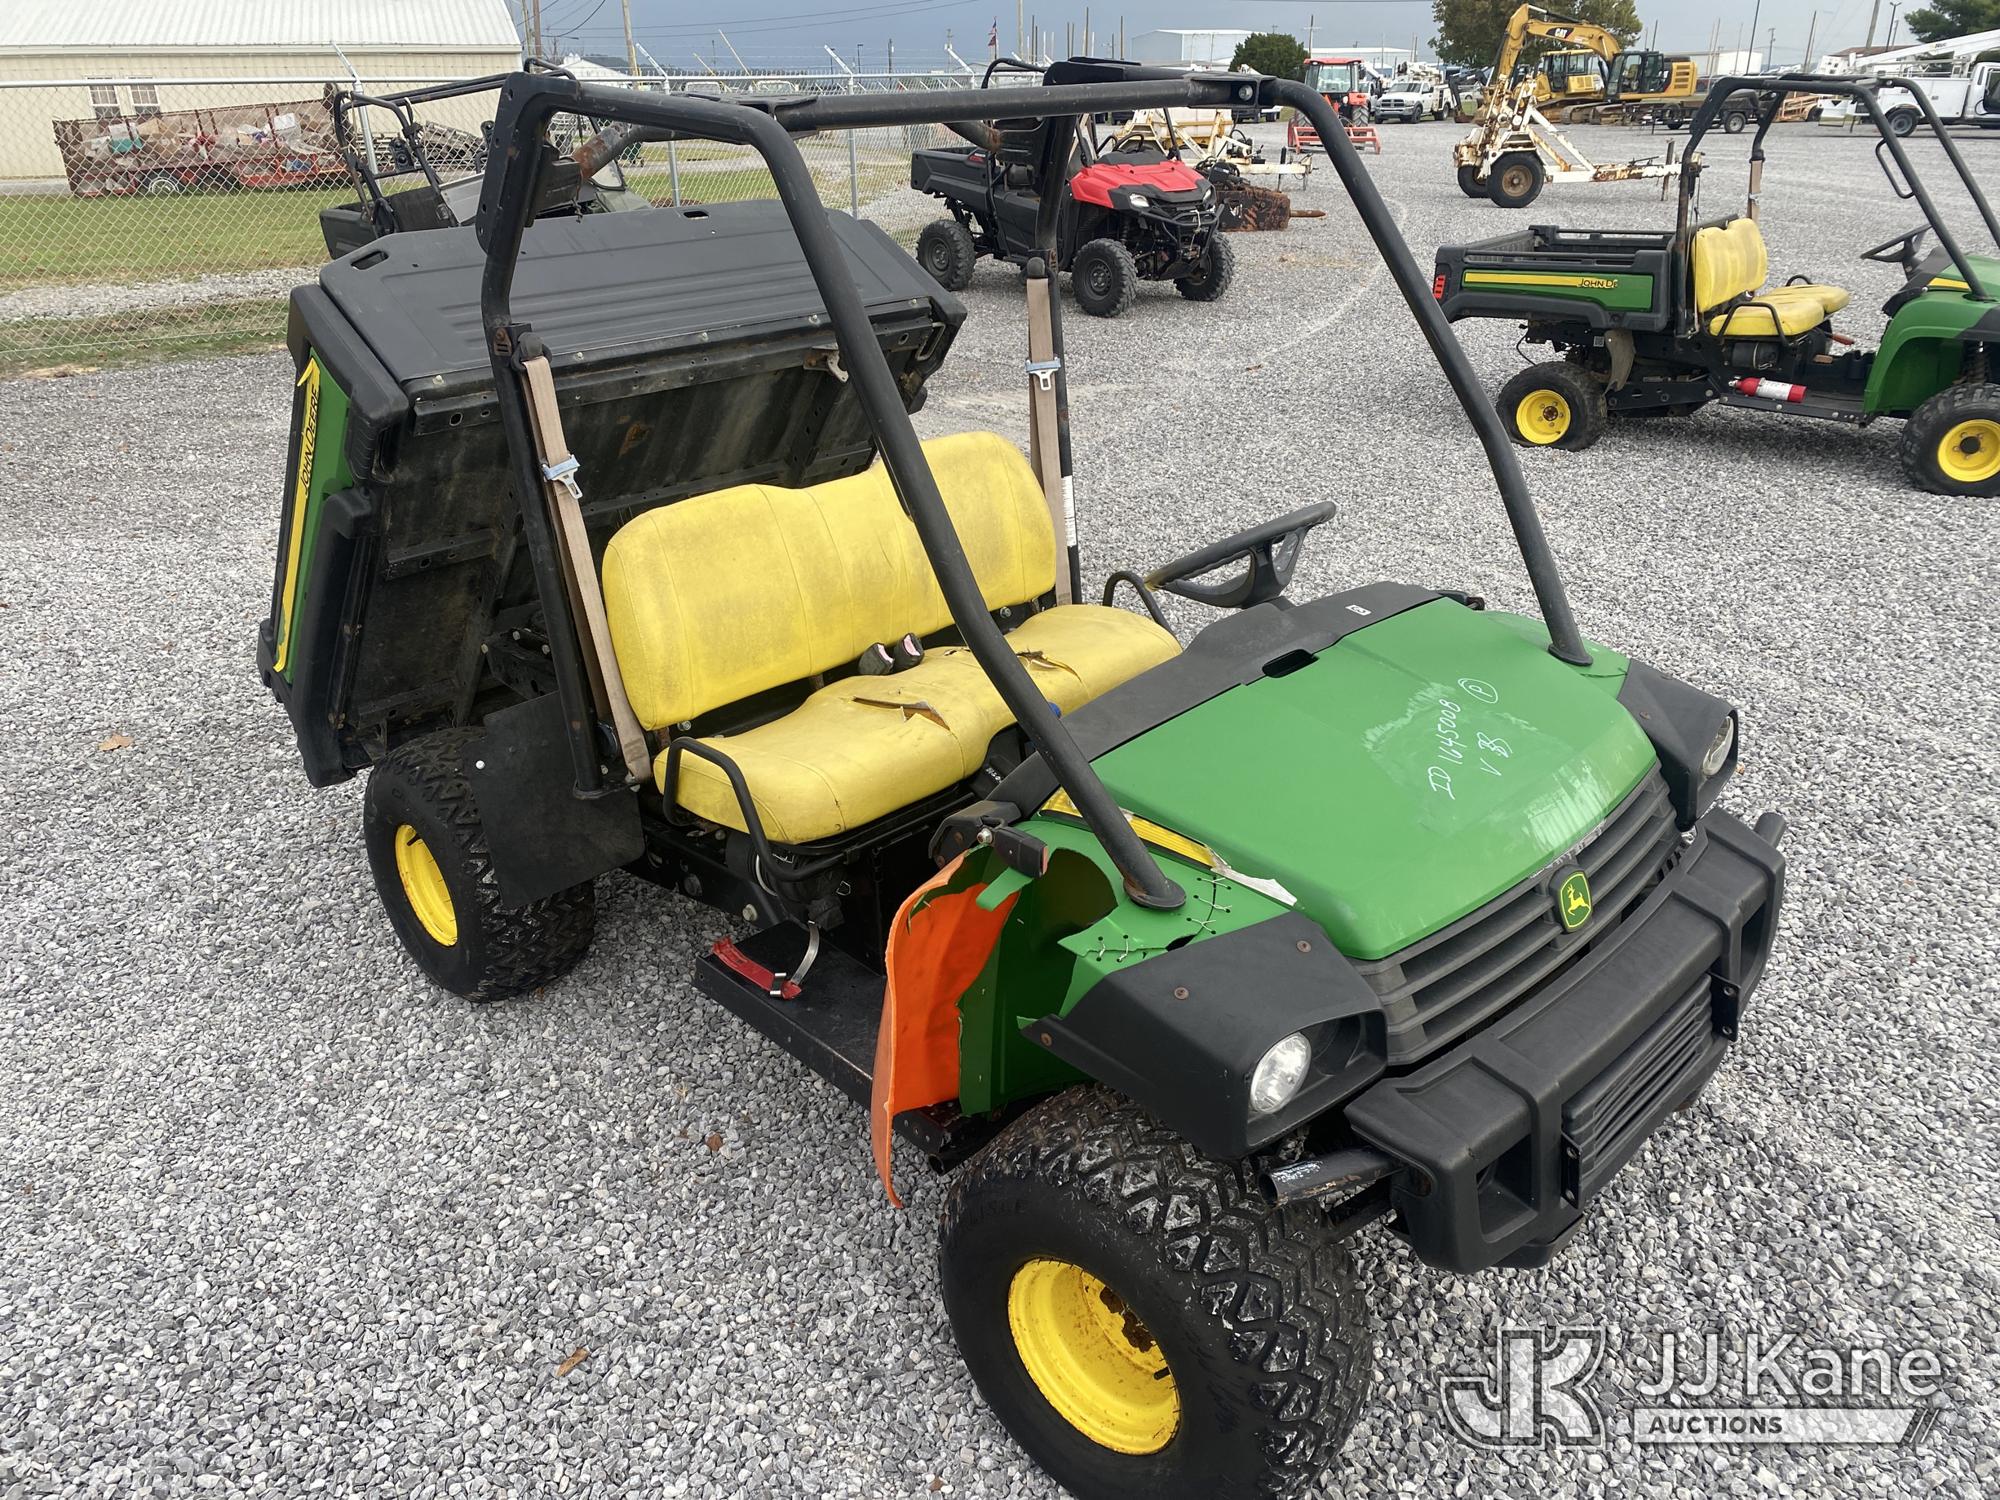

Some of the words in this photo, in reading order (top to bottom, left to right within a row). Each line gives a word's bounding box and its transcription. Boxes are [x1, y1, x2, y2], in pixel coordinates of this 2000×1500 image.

[1554, 27, 1568, 38] CAT
[1581, 278, 1604, 288] JOHN
[300, 445, 312, 495] JOHN
[306, 384, 319, 447] DEERE
[1427, 766, 1455, 800] ID
